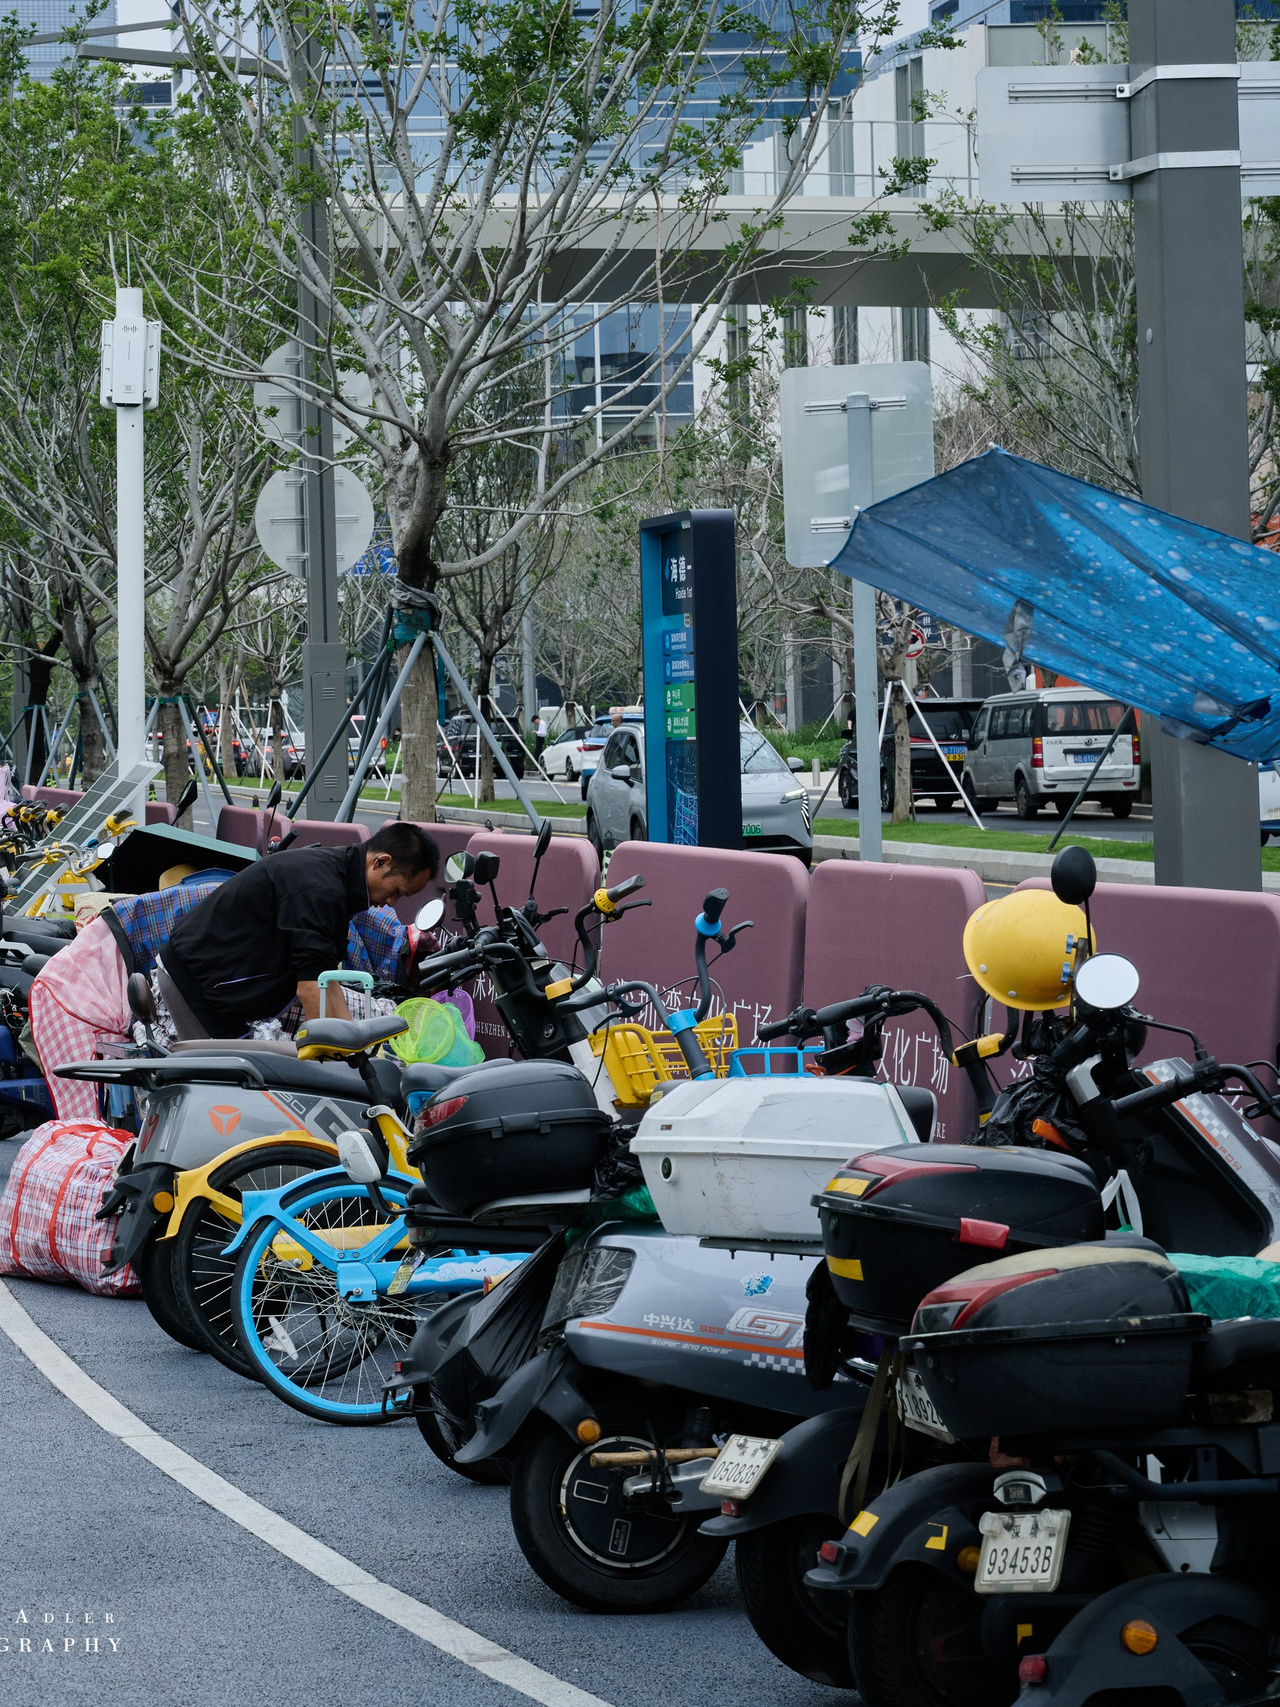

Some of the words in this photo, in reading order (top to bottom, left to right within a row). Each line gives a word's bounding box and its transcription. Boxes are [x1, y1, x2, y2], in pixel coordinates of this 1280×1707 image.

[476, 1021, 506, 1037] HENZHEN
[643, 1312, 695, 1333] 中兴达
[713, 1461, 760, 1485] 05083B
[987, 1545, 1053, 1575] 93453B
